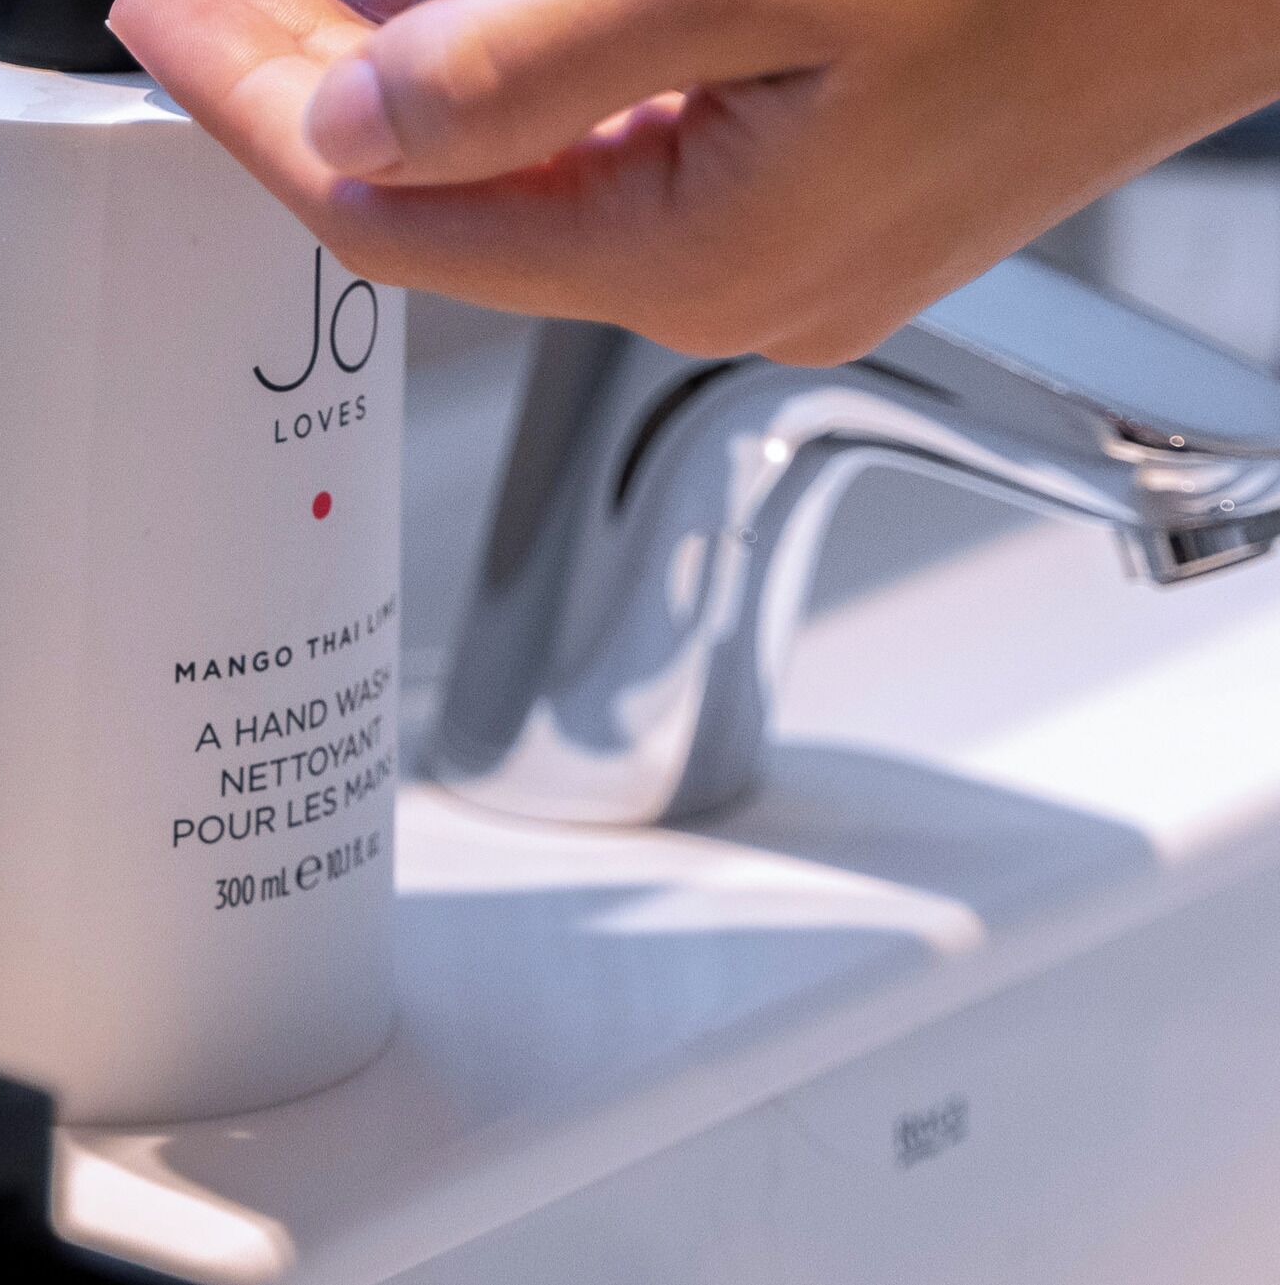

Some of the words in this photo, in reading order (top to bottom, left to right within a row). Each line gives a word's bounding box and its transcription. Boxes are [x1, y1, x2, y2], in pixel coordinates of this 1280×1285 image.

[253, 244, 379, 393] Jo
[273, 394, 367, 445] LOVES
[175, 645, 293, 684] MANGO
[306, 620, 361, 660] THAI
[194, 722, 222, 753] A
[234, 698, 328, 748] HAND
[221, 714, 383, 798] NETTOYANT
[173, 806, 276, 849] POUR
[287, 786, 338, 829] LES
[215, 873, 256, 911] 300
[261, 867, 290, 902] mL
